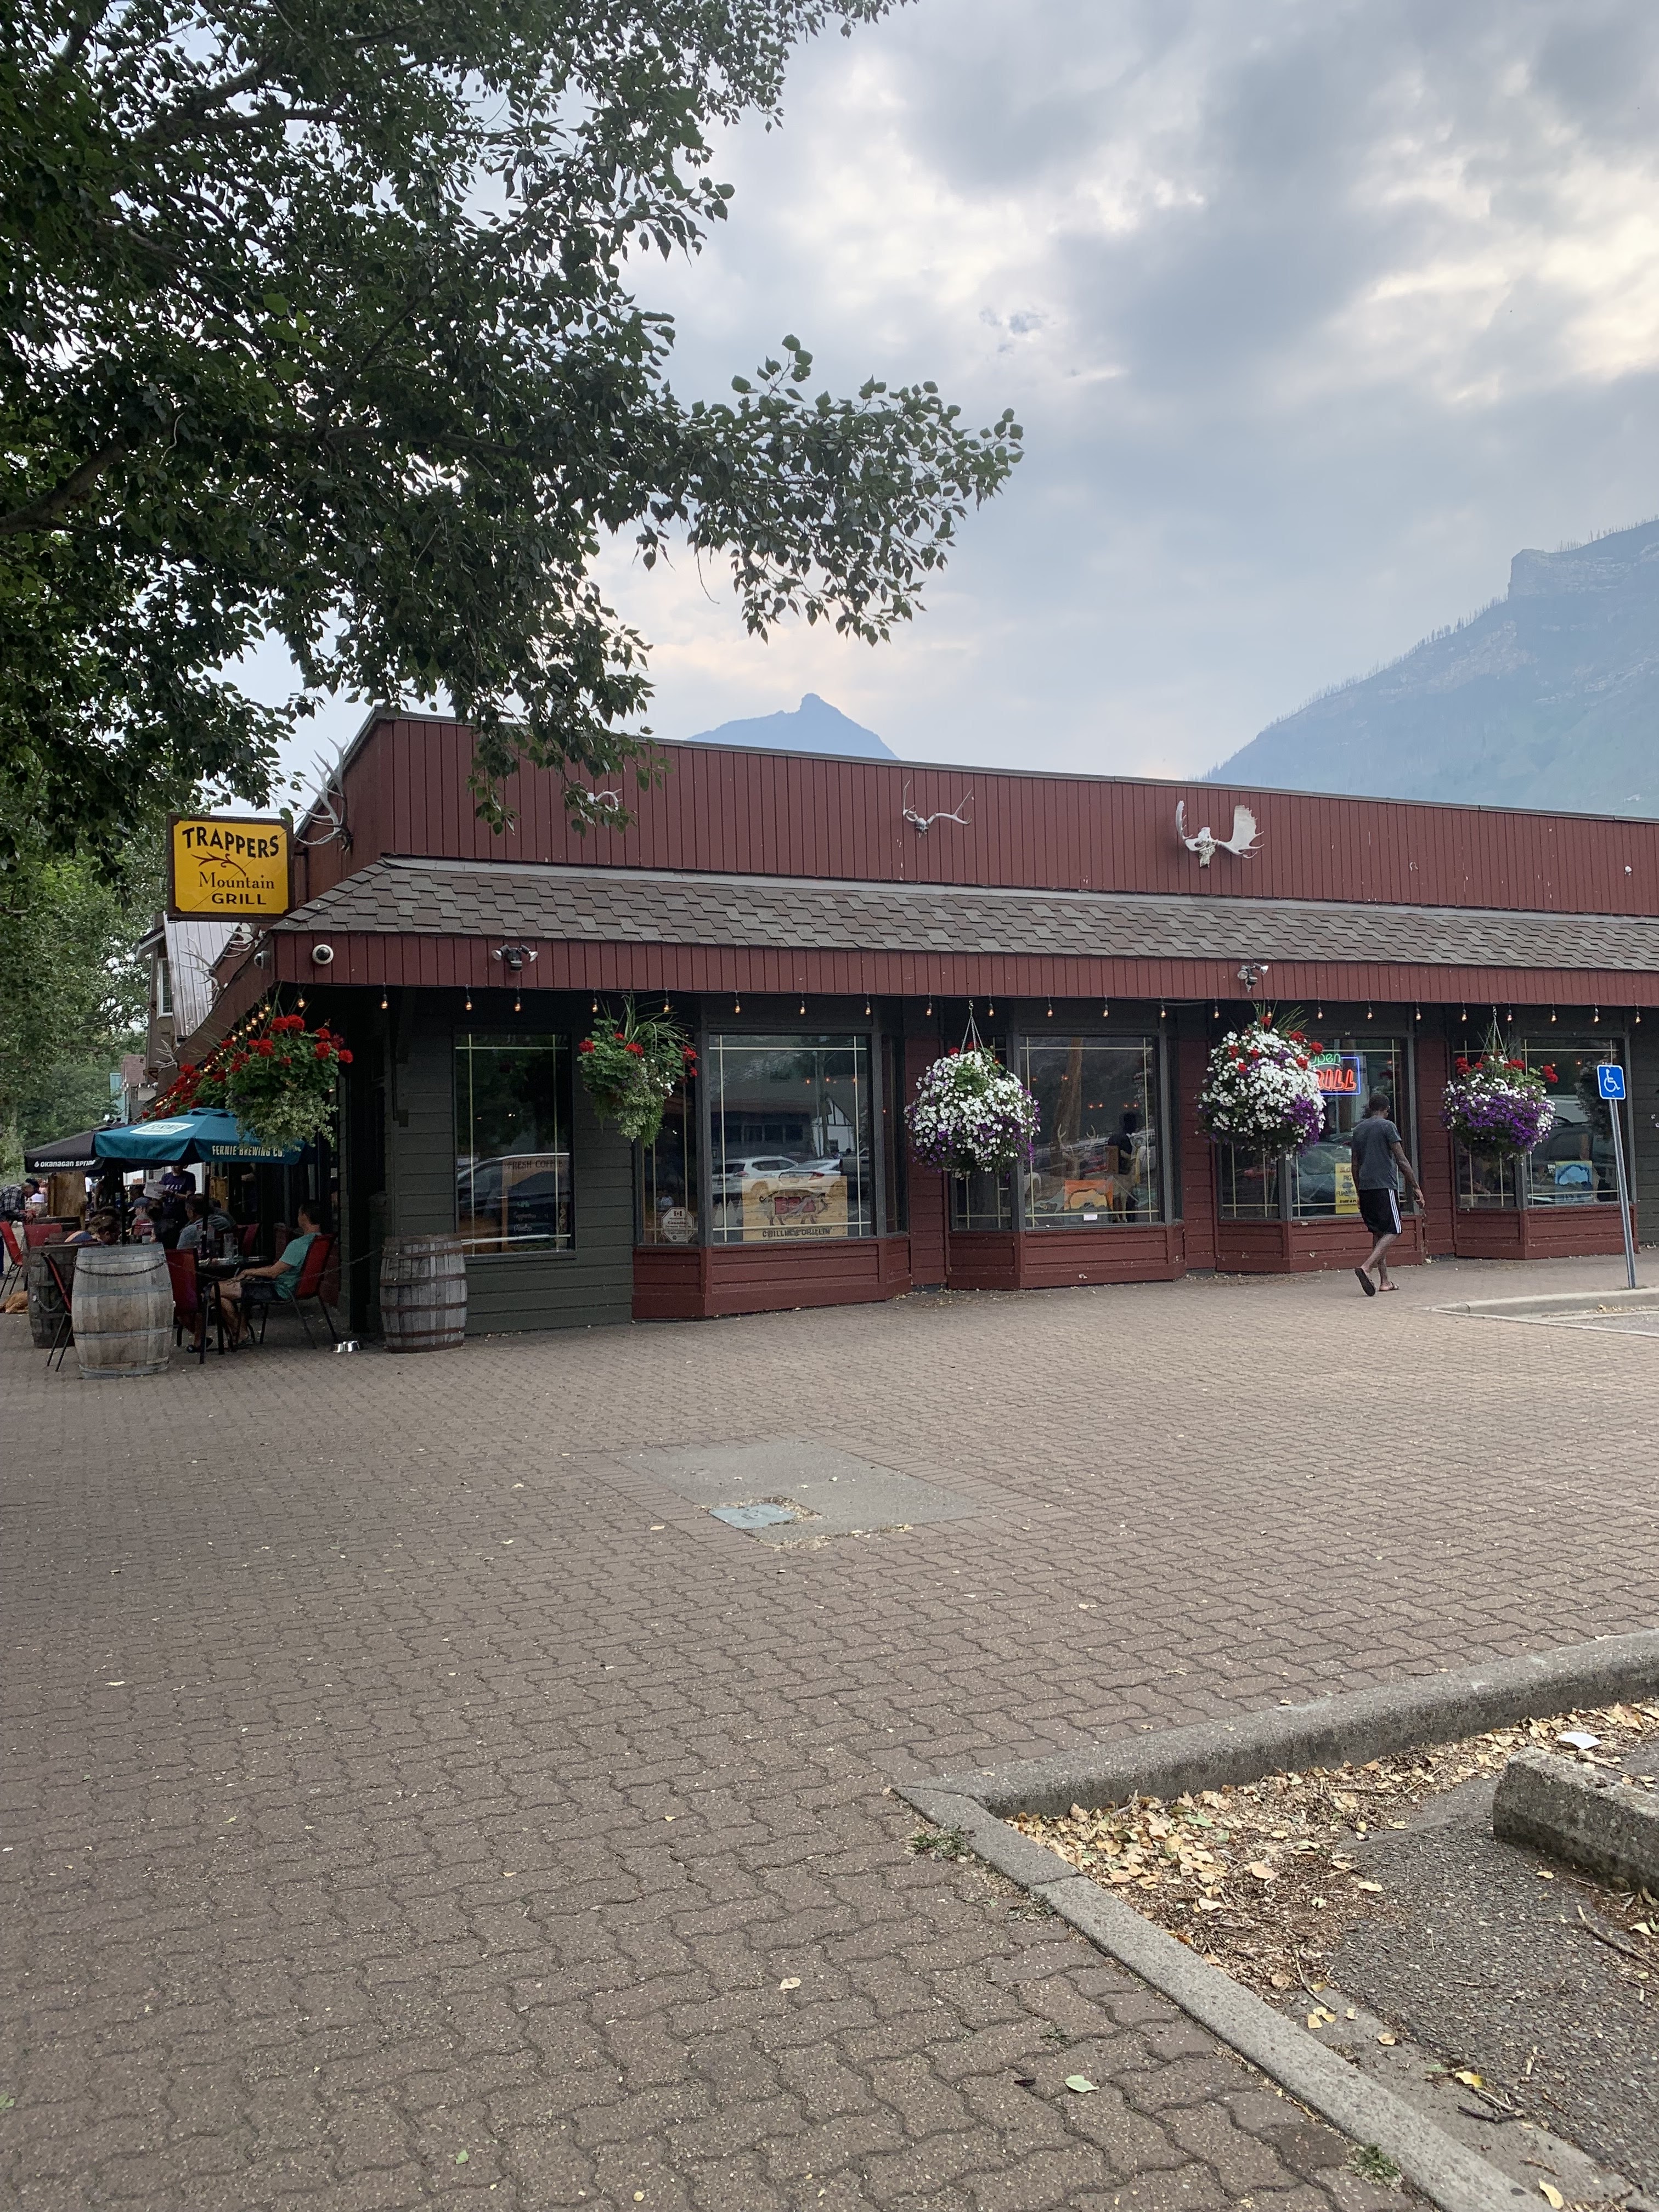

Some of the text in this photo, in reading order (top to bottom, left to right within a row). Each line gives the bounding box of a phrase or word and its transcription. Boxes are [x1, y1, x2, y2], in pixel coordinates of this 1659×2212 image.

[182, 826, 279, 858] TRAPPERS
[199, 871, 275, 889] Mountain
[212, 893, 267, 905] GRILL
[1317, 1069, 1357, 1091] RILL
[212, 1145, 237, 1155] FERNIE
[535, 1159, 563, 1168] COFFE
